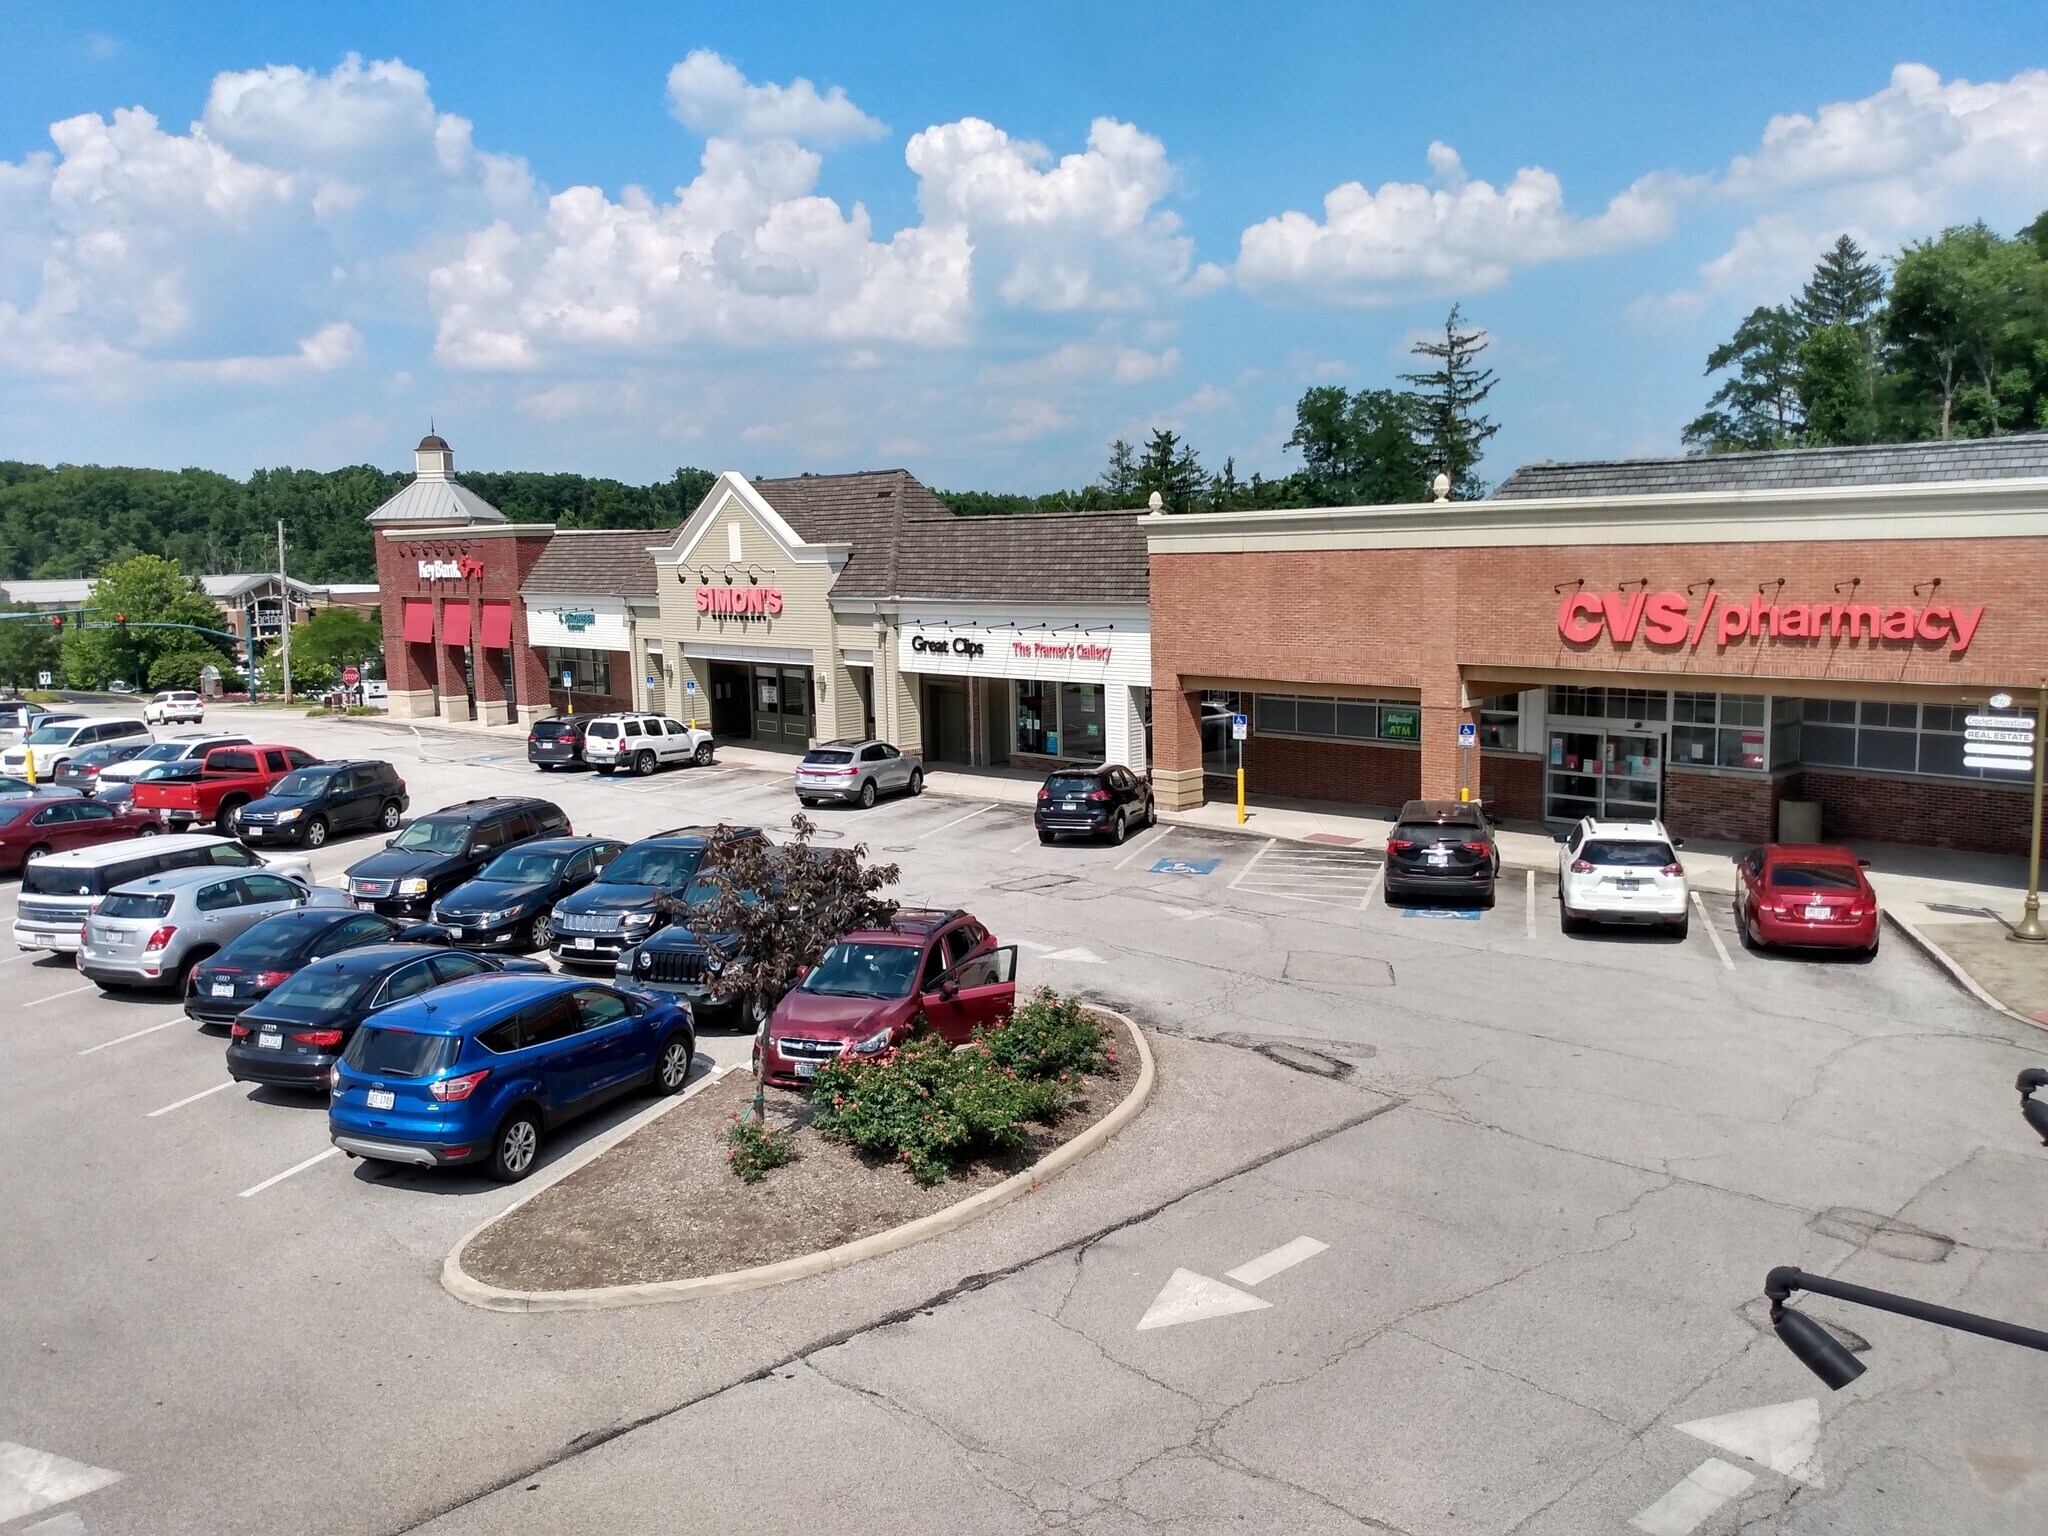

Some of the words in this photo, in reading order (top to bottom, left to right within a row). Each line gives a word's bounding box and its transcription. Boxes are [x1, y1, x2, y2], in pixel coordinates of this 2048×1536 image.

[418, 560, 461, 581] KeyBank
[695, 588, 782, 613] SIMON'S
[911, 635, 949, 653] Great
[953, 637, 984, 658] Clips
[1012, 642, 1029, 655] The
[1035, 643, 1074, 657] Framer's
[1077, 644, 1112, 664] Gallery
[344, 673, 359, 681] STOP
[1387, 714, 1413, 725] Allpoint
[1967, 716, 1993, 726] Crochet
[1994, 718, 2032, 728] Innovations
[1389, 725, 1411, 736] ATM
[1967, 731, 1993, 739] REAL
[1994, 732, 2030, 741] ESTATE
